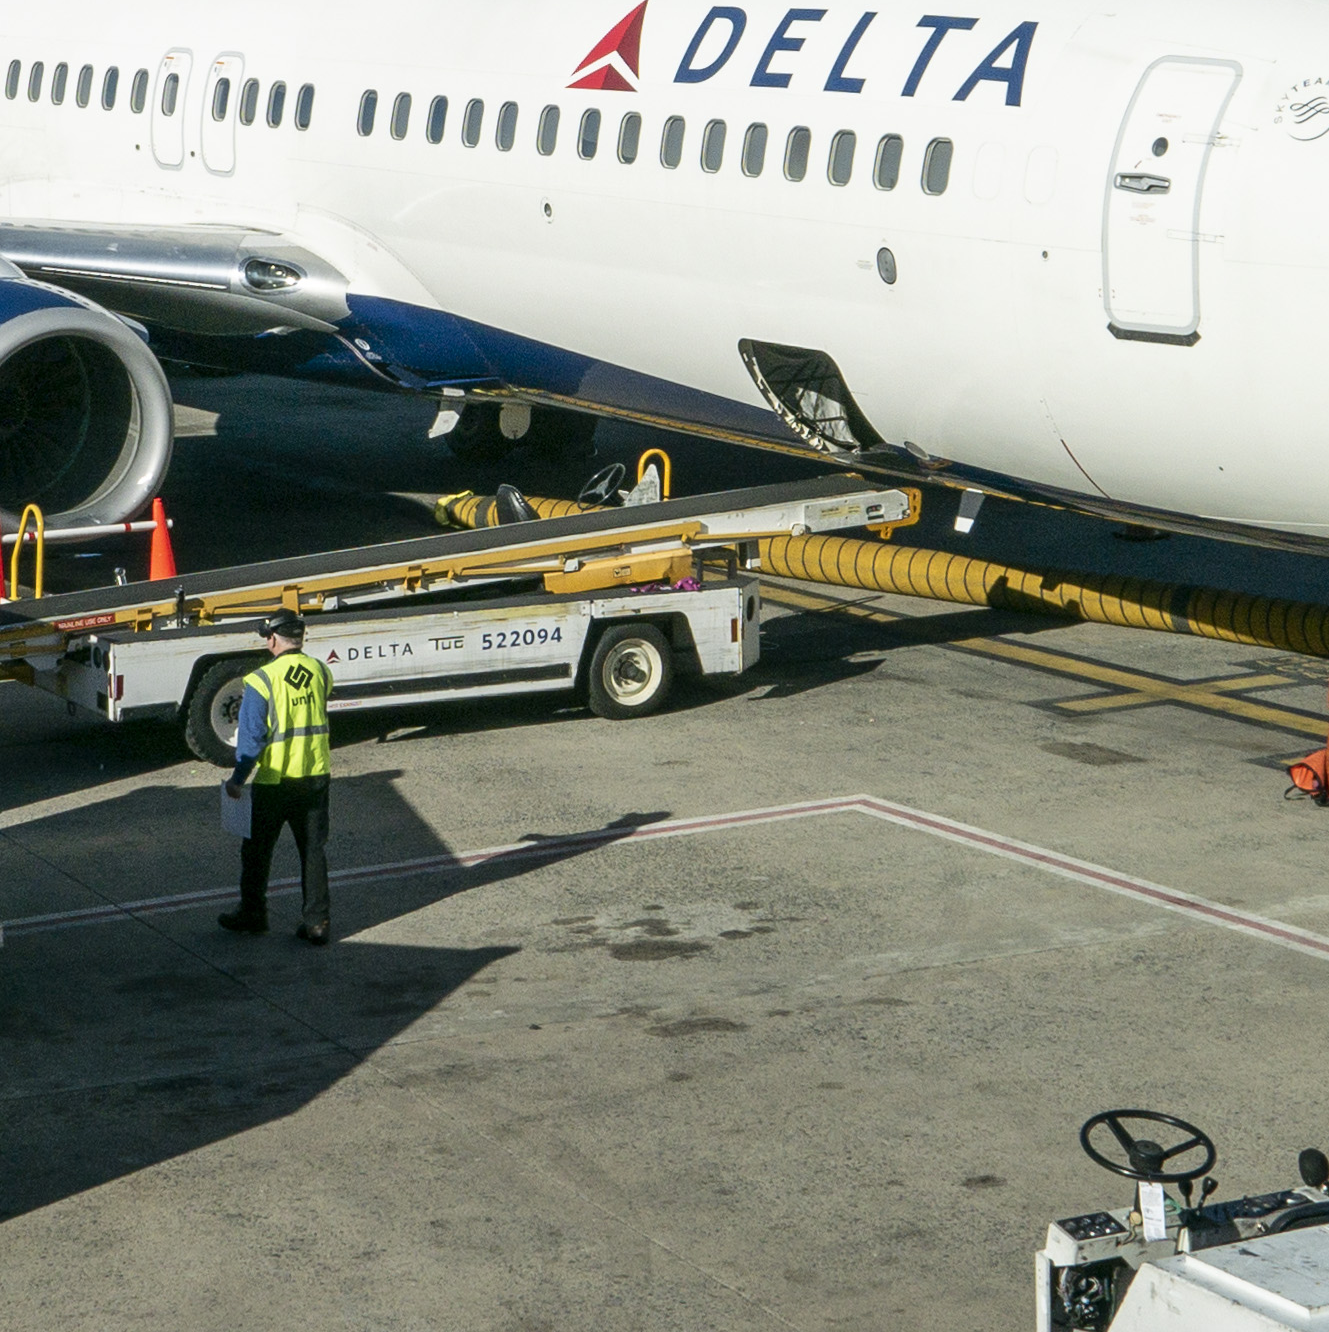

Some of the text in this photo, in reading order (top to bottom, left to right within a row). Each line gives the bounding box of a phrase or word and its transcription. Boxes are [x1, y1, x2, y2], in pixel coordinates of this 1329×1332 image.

[672, 5, 1040, 107] DELTA
[85, 617, 97, 626] USE
[97, 616, 112, 624] ONLY
[348, 626, 563, 661] DELTA TUG 522094
